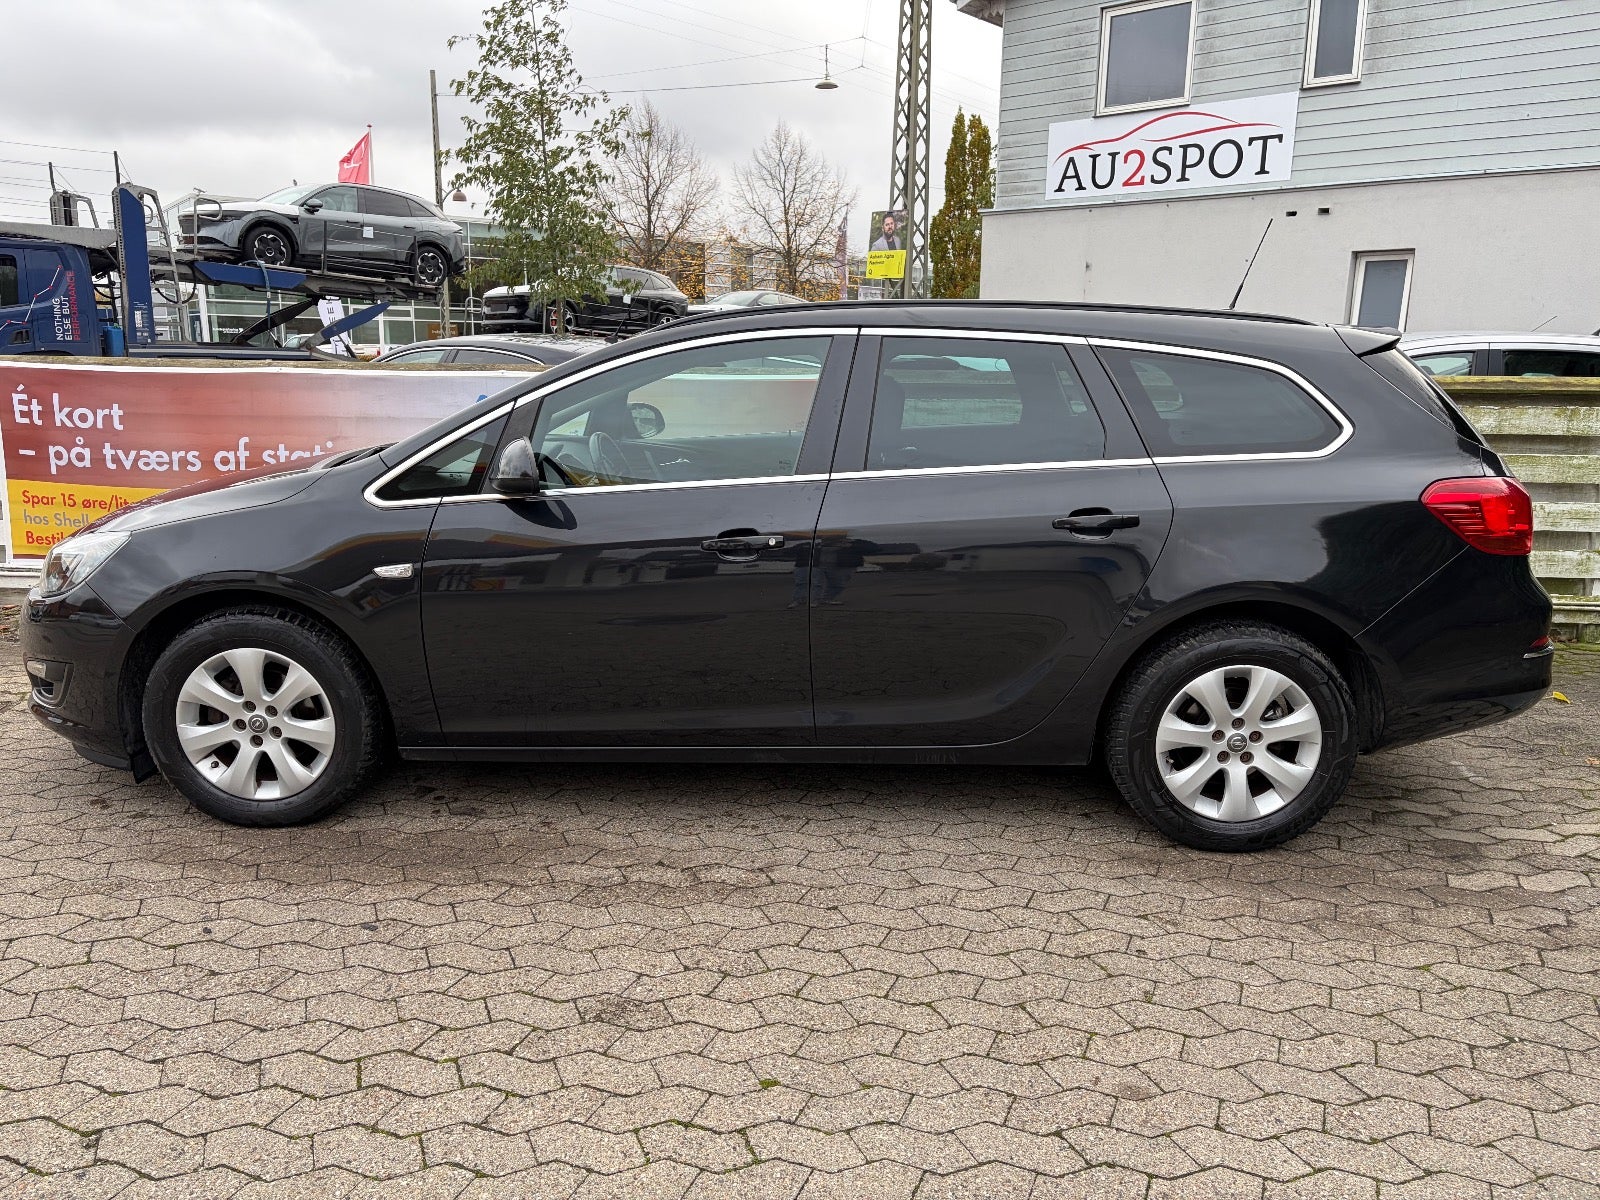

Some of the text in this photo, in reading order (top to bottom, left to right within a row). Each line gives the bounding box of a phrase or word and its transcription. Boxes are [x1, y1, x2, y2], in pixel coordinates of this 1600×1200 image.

[1053, 133, 1284, 193] AU2SPOT
[53, 298, 64, 341] NOTHING
[61, 296, 73, 341] ELSE BUT
[66, 271, 80, 341] PERFORMANCE
[11, 383, 124, 431] Ét kort
[48, 436, 92, 475] på
[103, 442, 202, 472] tværs
[213, 436, 250, 471] af
[21, 489, 134, 512] Spar 15 øre/lit
[23, 508, 90, 528] hos Shell
